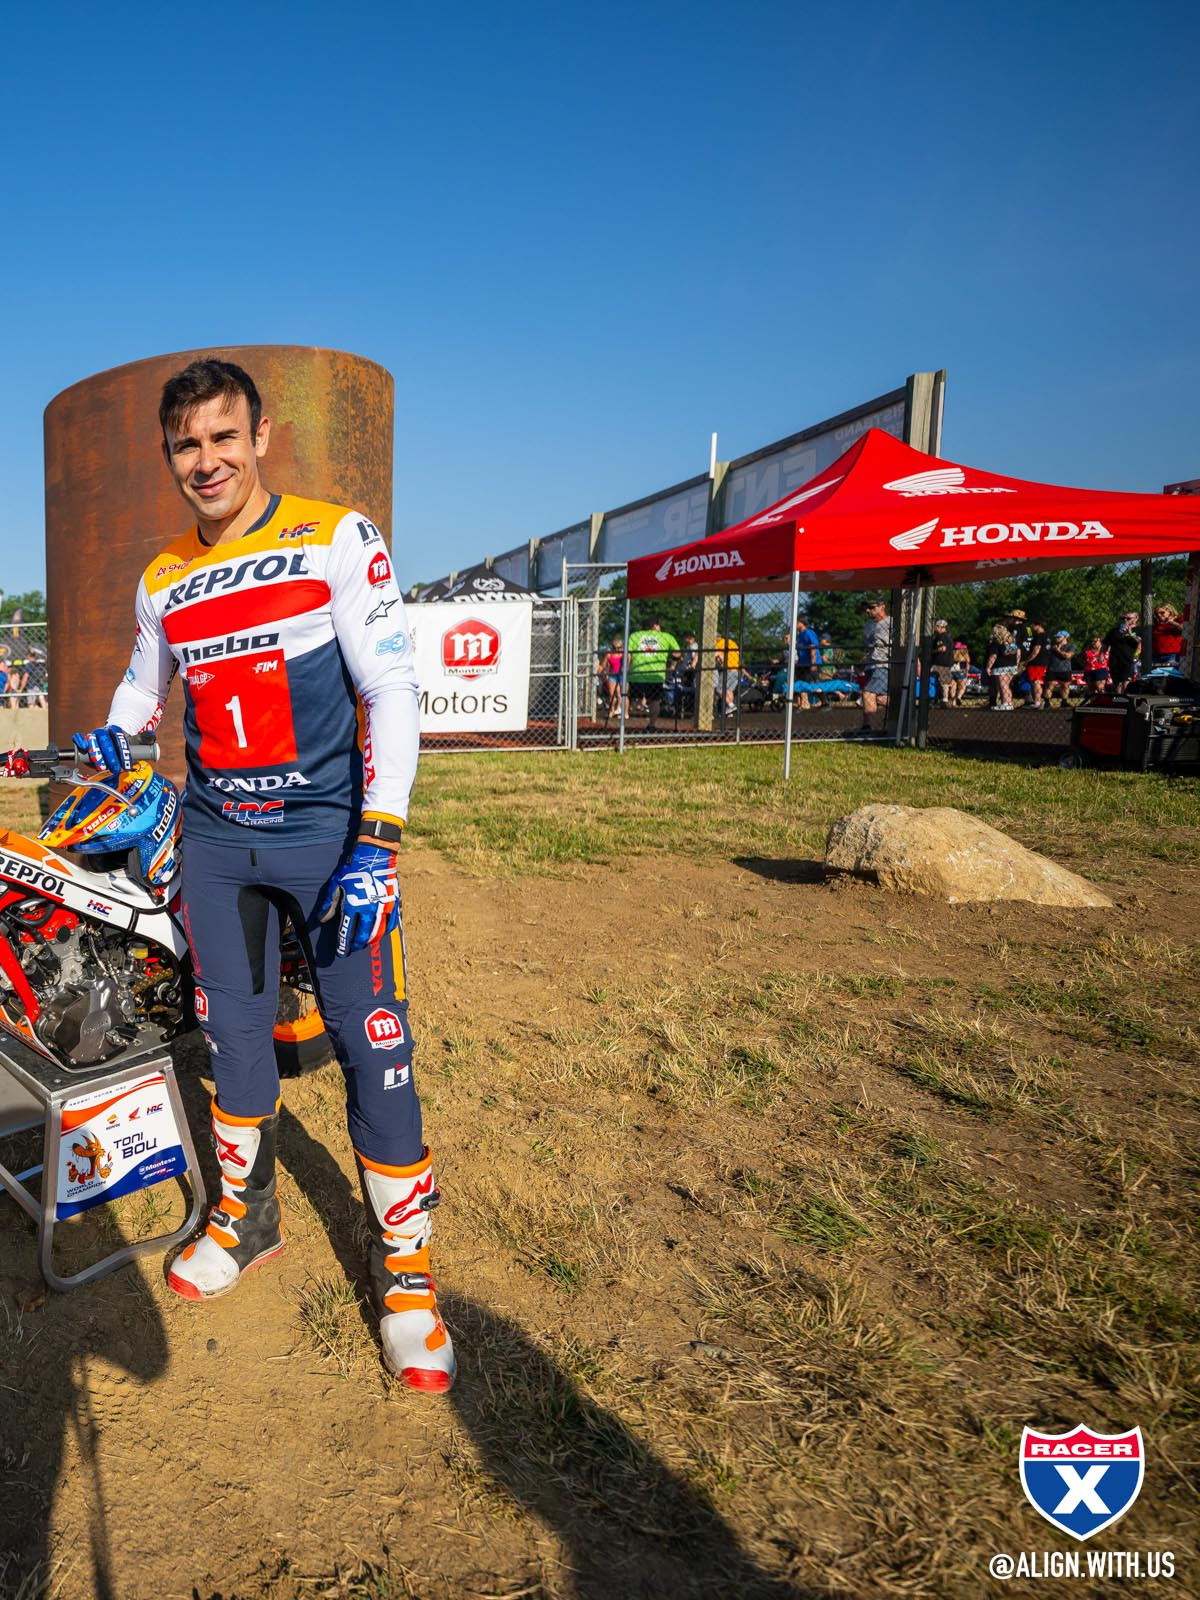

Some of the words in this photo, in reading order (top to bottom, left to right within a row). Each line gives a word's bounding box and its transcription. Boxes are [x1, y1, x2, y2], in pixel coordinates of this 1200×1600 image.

[278, 521, 321, 541] HRC
[940, 520, 1115, 548] HONDA
[673, 550, 746, 577] HONDA
[165, 553, 309, 610] REPSOL
[182, 632, 280, 663] hebo
[255, 659, 278, 673] FIM
[448, 667, 493, 675] Montesa
[225, 695, 248, 749] 1
[153, 791, 177, 841] hebo
[222, 800, 284, 822] HRC
[83, 808, 116, 836] hebo
[87, 900, 113, 915] HRC
[146, 1103, 164, 1115] HRC
[113, 1132, 143, 1149] TONI
[122, 1138, 158, 1159] BOU
[145, 1156, 176, 1171] Montesa
[67, 1180, 94, 1193] WORLD
[67, 1181, 107, 1198] CHAMPION
